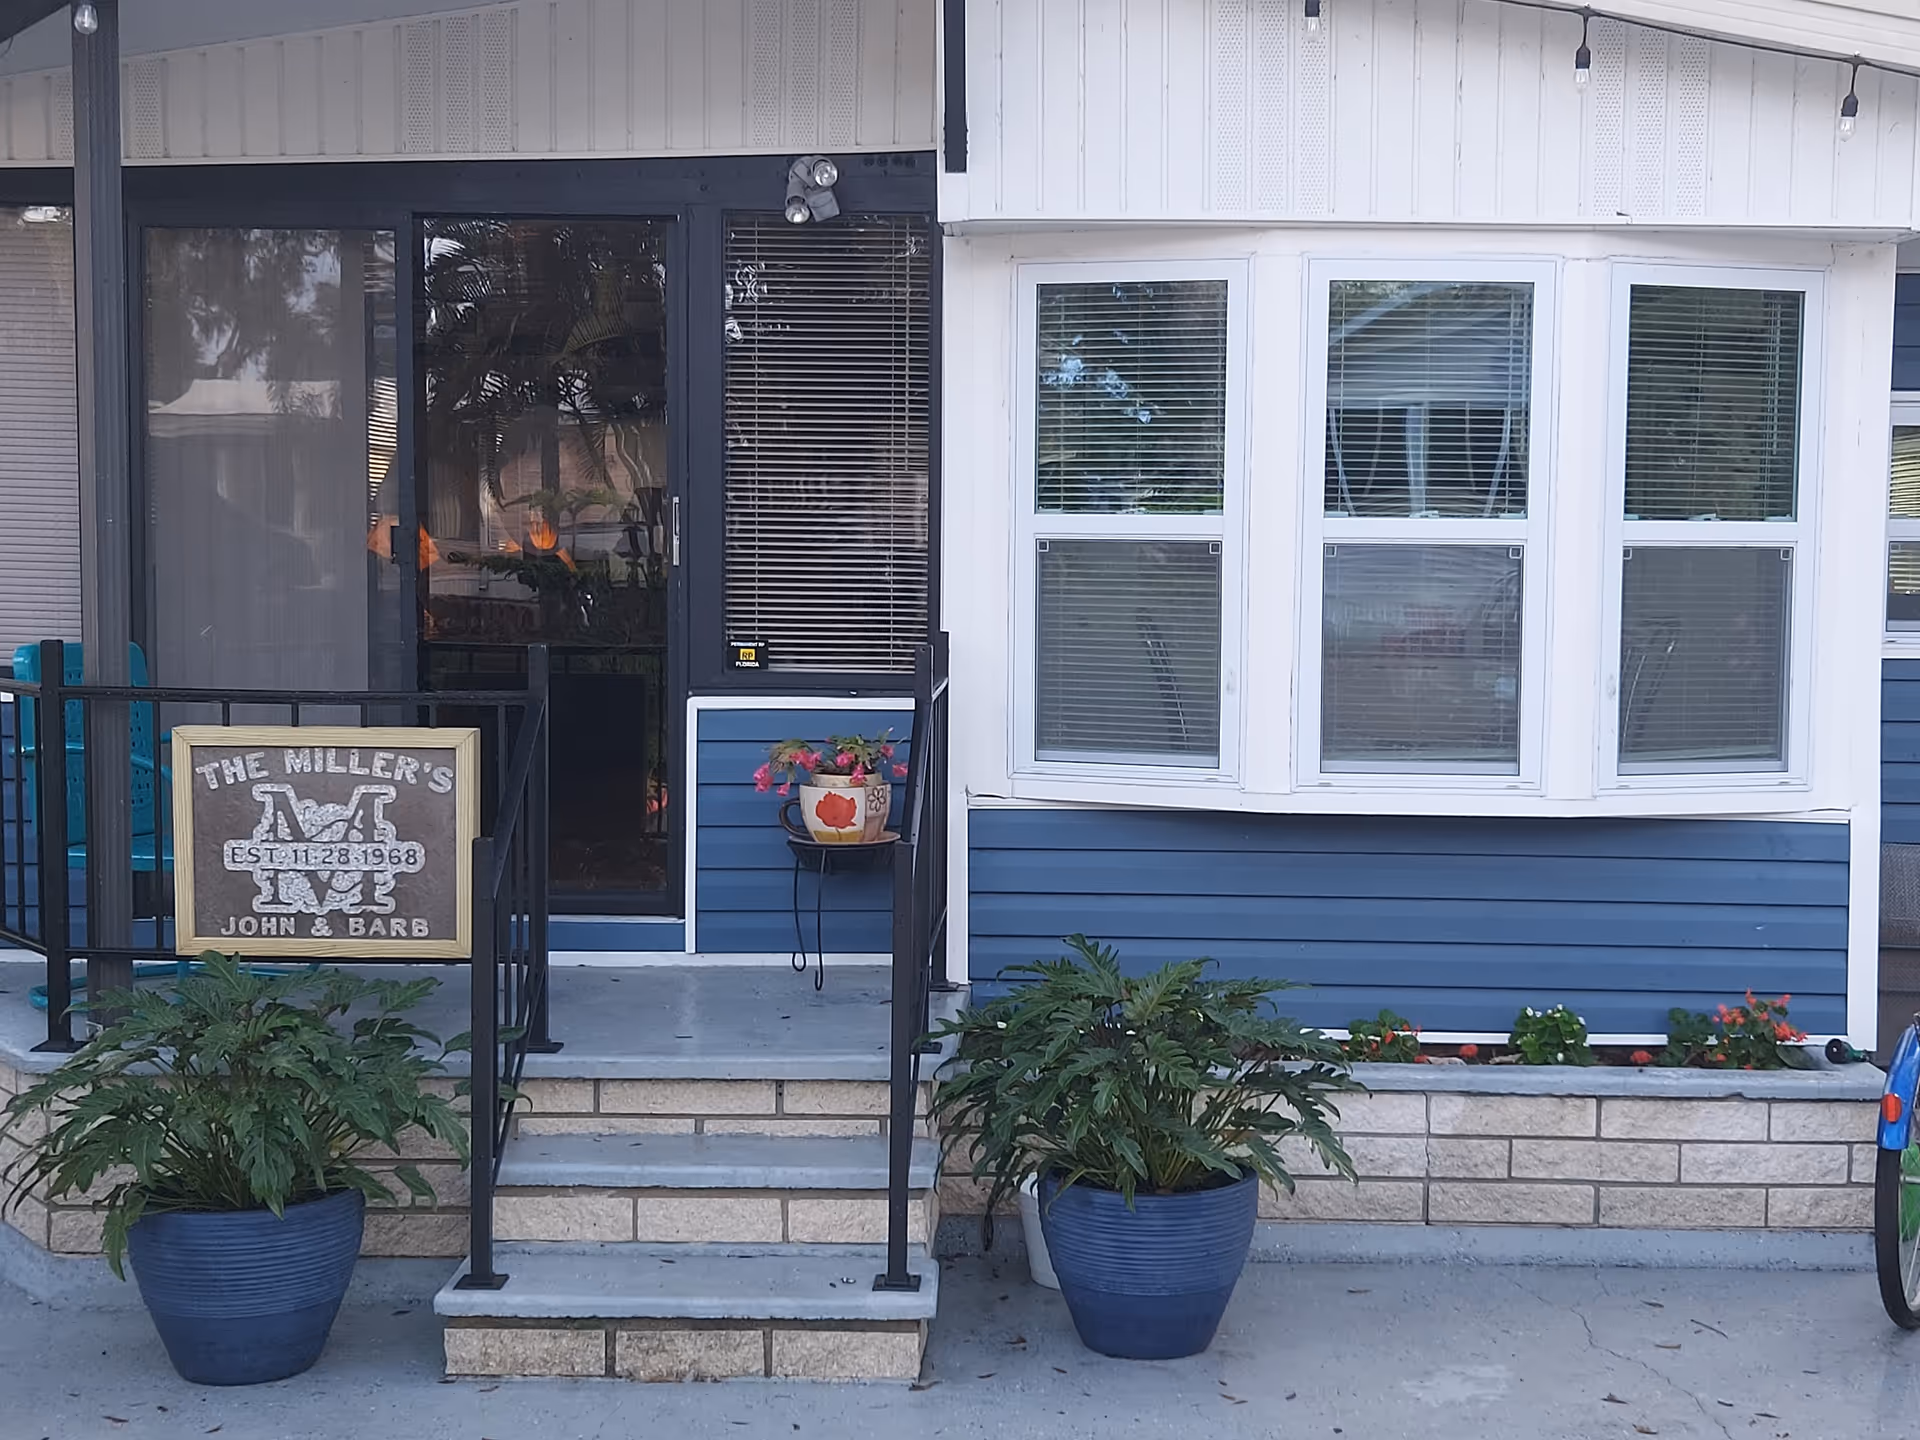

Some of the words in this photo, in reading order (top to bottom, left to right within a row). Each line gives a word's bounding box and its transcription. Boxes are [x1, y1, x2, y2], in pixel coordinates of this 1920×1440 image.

[742, 652, 754, 660] RP
[195, 752, 270, 790] THE
[283, 748, 455, 793] MILLER'S
[220, 917, 296, 937] JOHN
[311, 916, 334, 937] &
[348, 917, 430, 937] BARB
